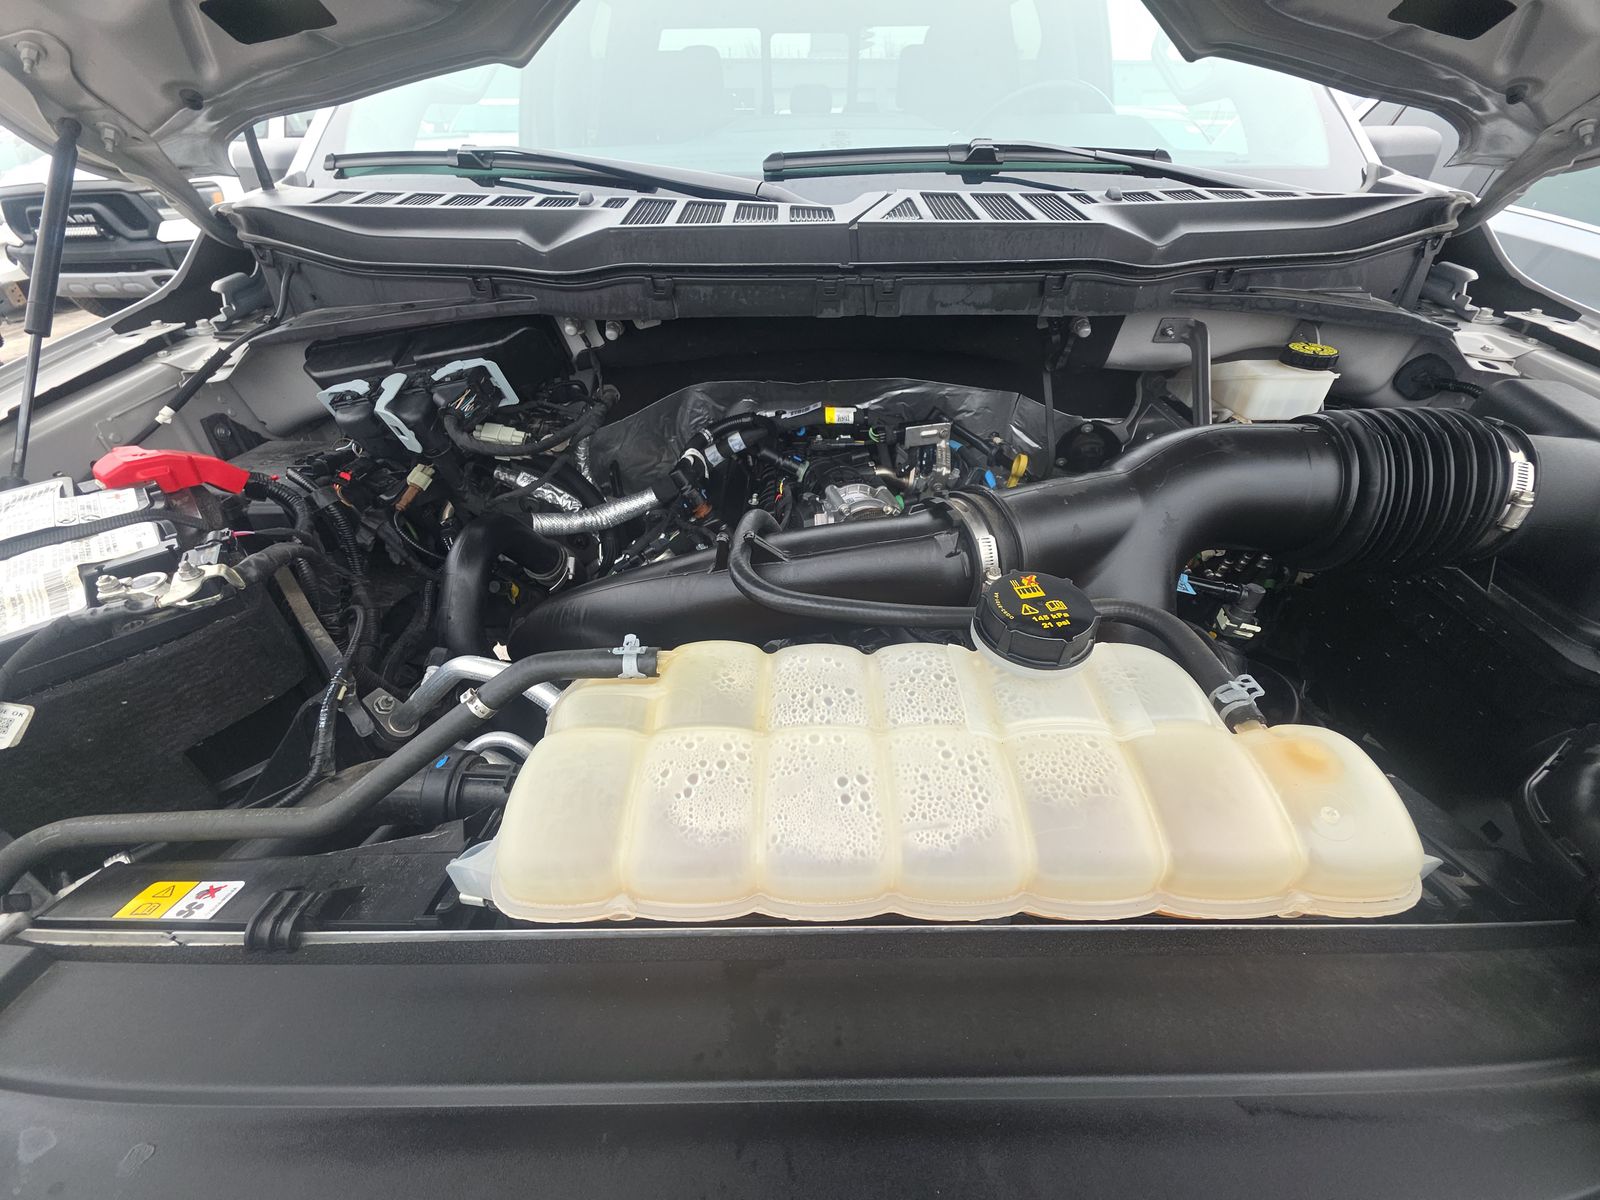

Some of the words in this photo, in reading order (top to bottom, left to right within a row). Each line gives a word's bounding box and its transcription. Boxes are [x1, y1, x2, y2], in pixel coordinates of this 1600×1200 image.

[1032, 614, 1050, 622] 145
[1051, 612, 1070, 620] kPa
[1056, 620, 1071, 628] psi
